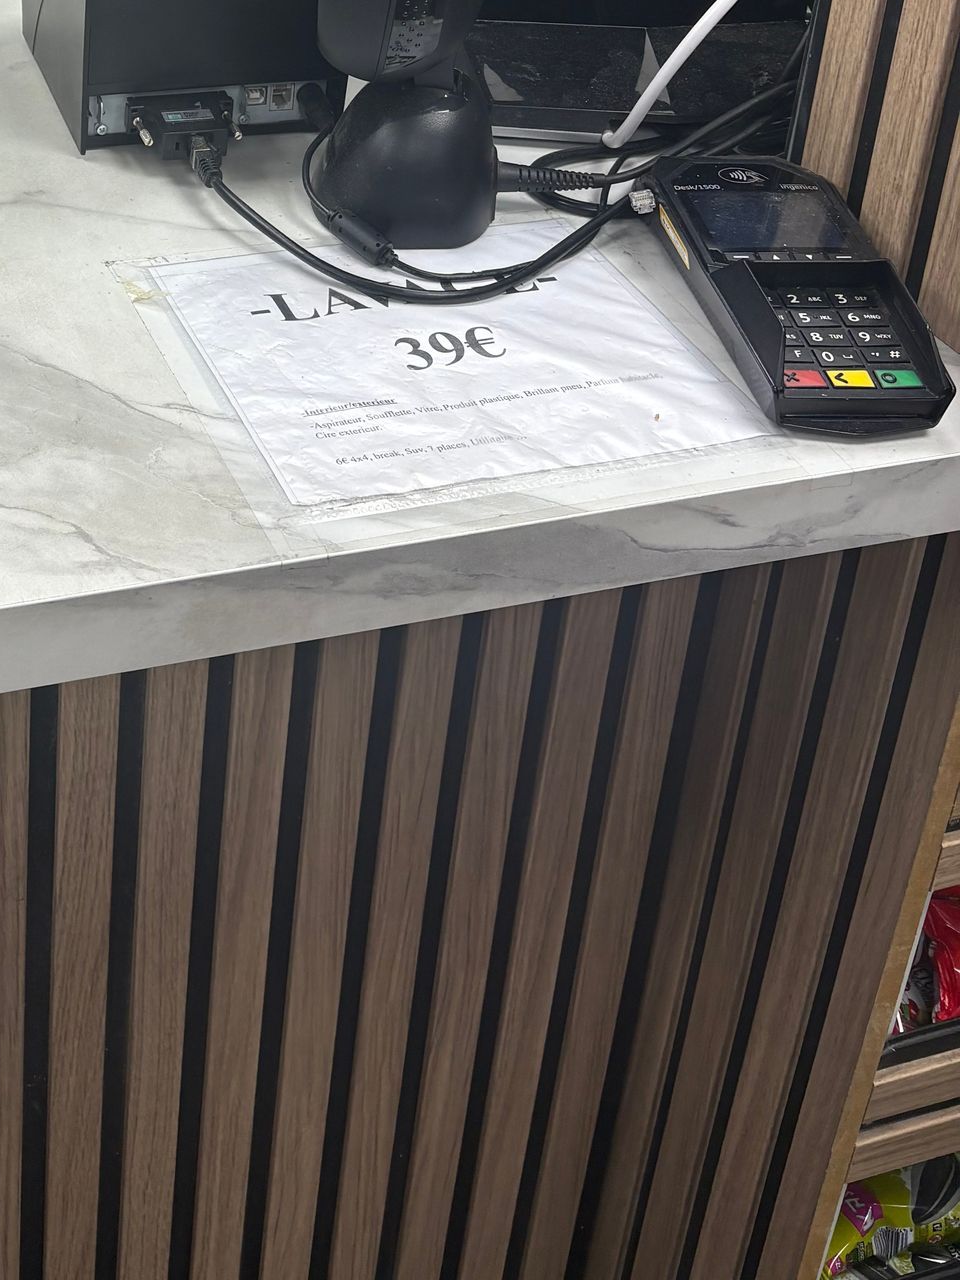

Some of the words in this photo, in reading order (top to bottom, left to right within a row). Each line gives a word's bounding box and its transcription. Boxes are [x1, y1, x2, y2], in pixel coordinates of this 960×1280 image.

[787, 294, 800, 303] 2
[835, 294, 847, 304] 3
[798, 313, 811, 323] 5
[847, 312, 860, 322] 6
[810, 332, 823, 342] 8
[858, 331, 871, 342] 9
[394, 325, 507, 371] 39€
[794, 350, 802, 358] F
[821, 351, 834, 362] 0
[310, 416, 365, 431] -Aspirateur,
[415, 404, 443, 415] Vitre,
[443, 399, 478, 412] Produit
[479, 391, 523, 408] plastique,
[523, 386, 559, 398] Brillant
[560, 382, 587, 394] pneu,
[315, 430, 337, 440] Cire
[338, 424, 383, 438] exterieur.
[336, 457, 350, 466] 6€
[350, 453, 373, 465] 4x4,
[373, 448, 405, 461] break,
[405, 445, 427, 456] Suv,
[427, 444, 434, 453] 7
[436, 439, 470, 453] places,
